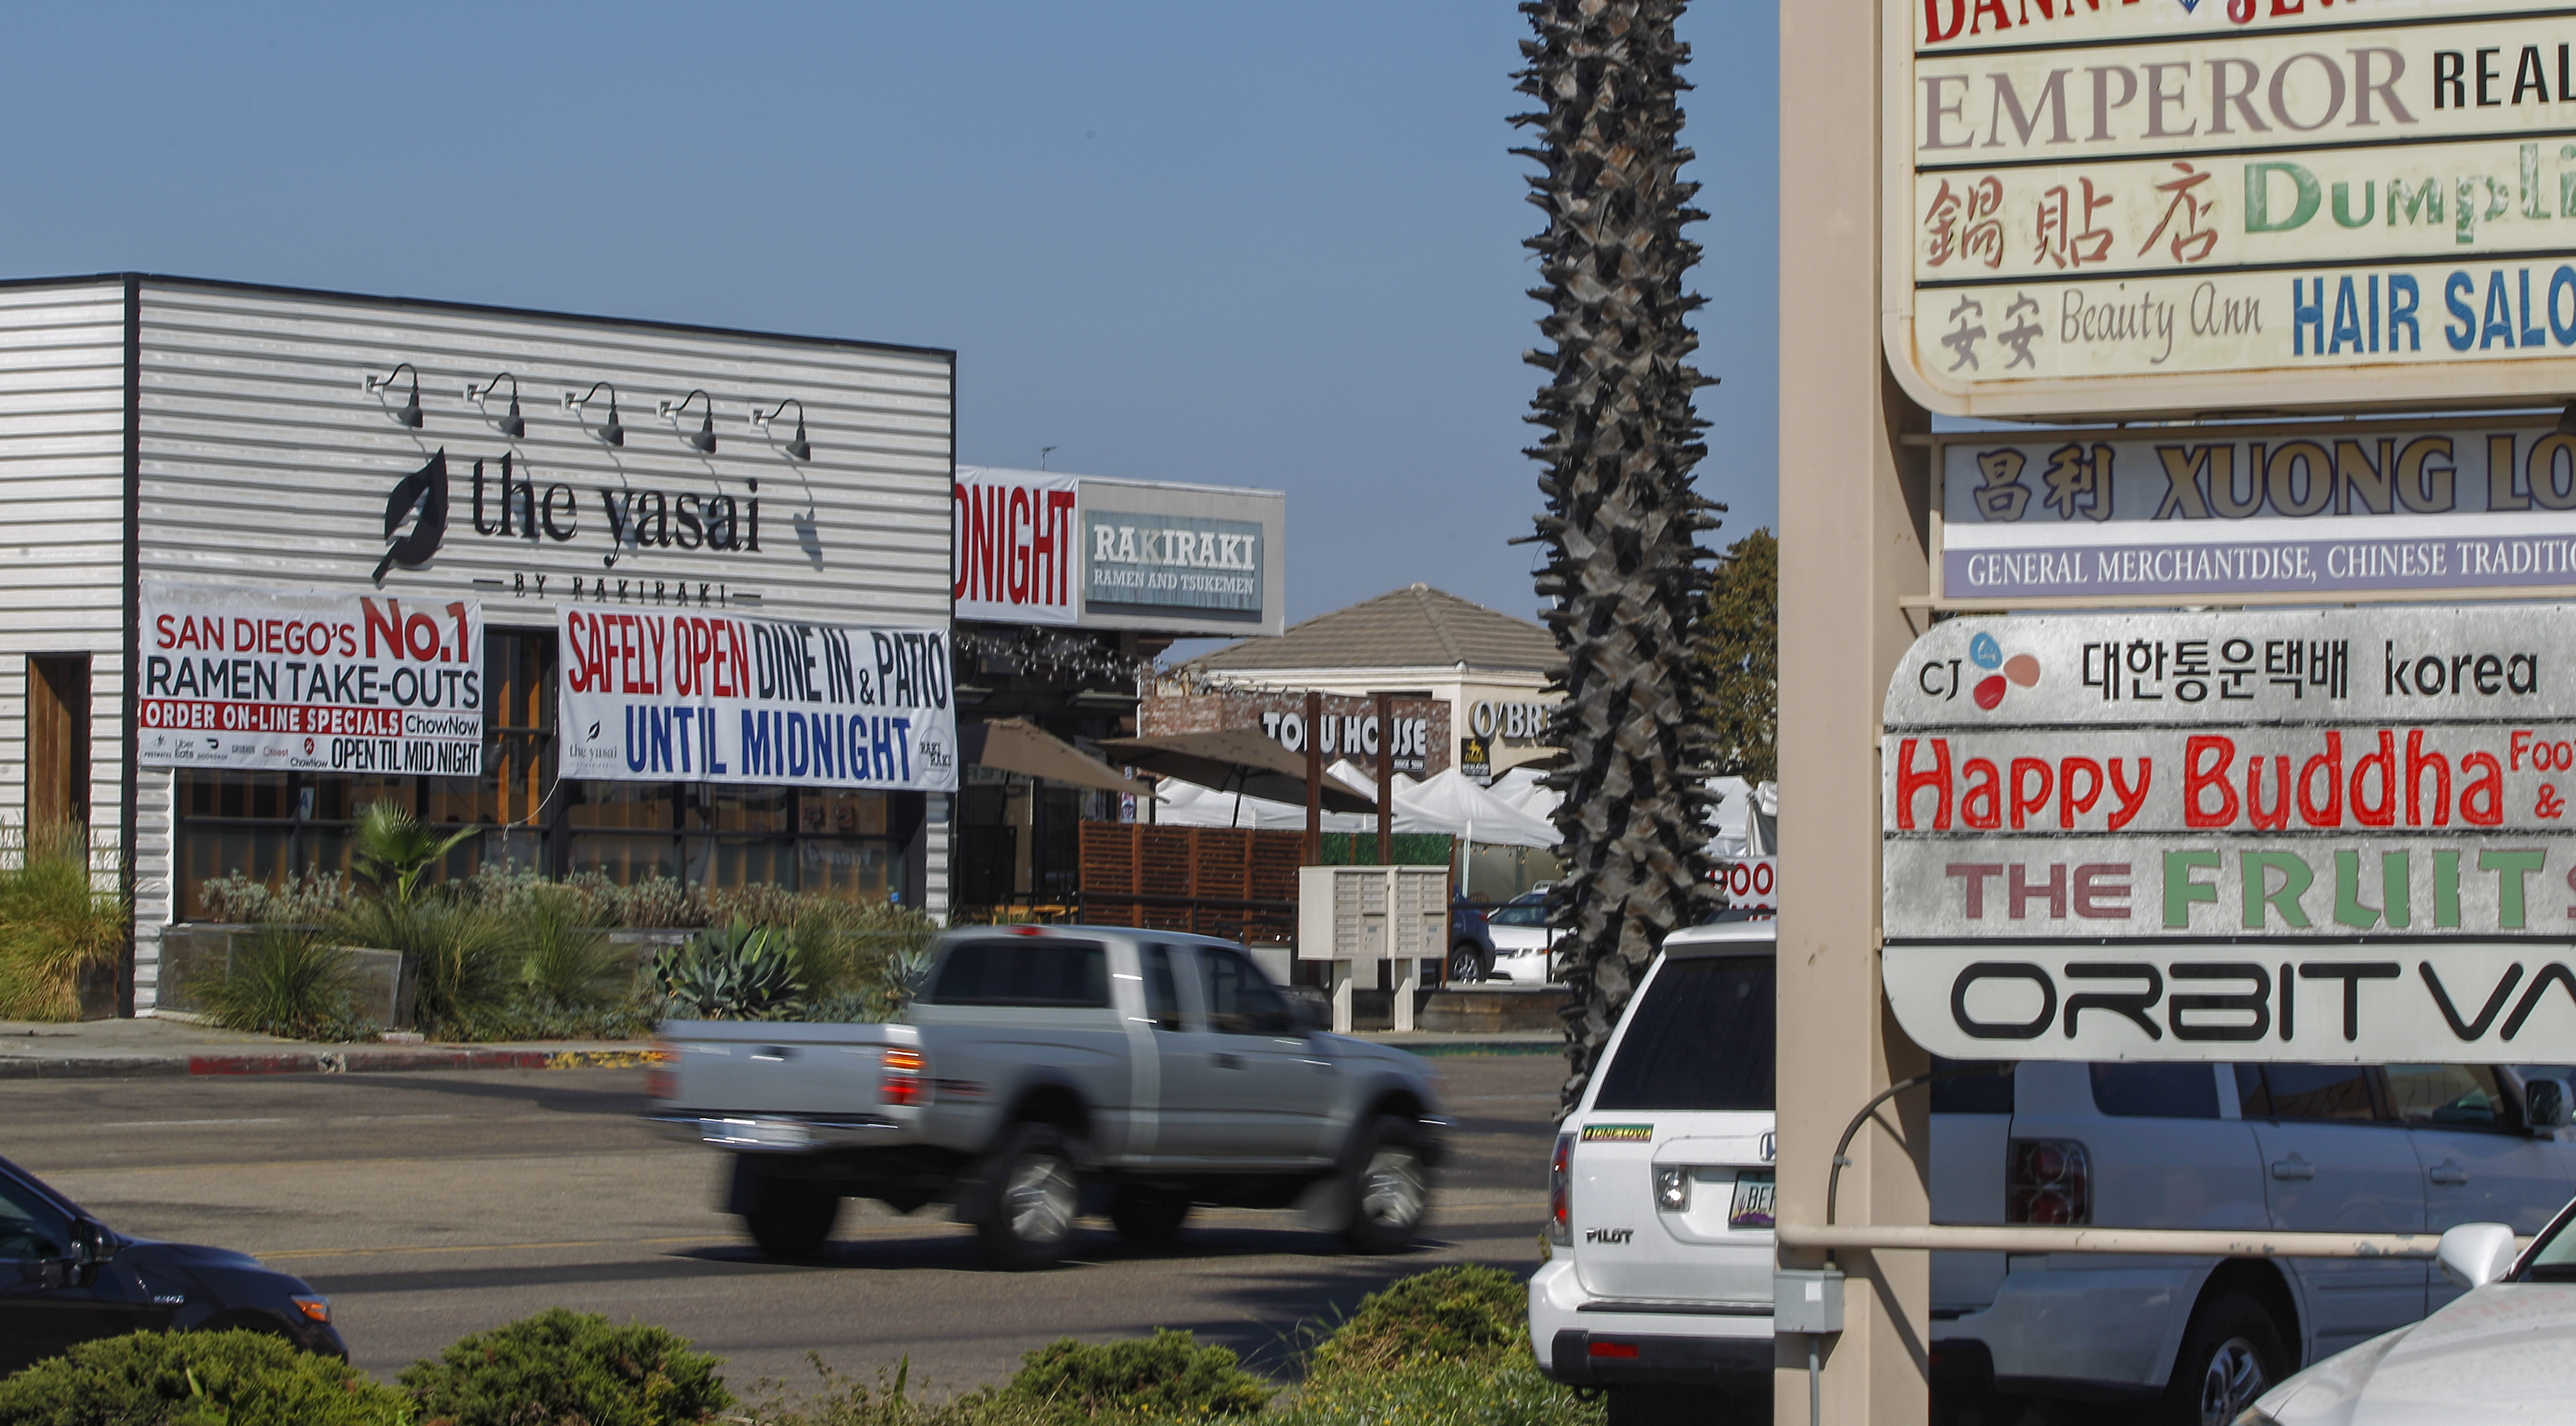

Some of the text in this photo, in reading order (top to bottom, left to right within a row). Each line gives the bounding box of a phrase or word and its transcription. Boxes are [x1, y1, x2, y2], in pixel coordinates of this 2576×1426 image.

[1918, 42, 2576, 151] EMPEROR REAL
[1923, 161, 2219, 269] 鍋貼店
[1940, 291, 2044, 371] 安安
[2060, 281, 2264, 364] Beauty Ann
[2292, 266, 2576, 357] HAIR SALO
[1972, 442, 2115, 523] 昌利
[2152, 431, 2576, 521] XUONG LO
[473, 450, 762, 567] the yasai
[1094, 524, 1255, 571] RAKIRAKI
[1968, 551, 2088, 586] GENERAL
[2097, 546, 2317, 584] MERCHANTDISE,
[2327, 542, 2447, 579] CHINESE
[513, 572, 727, 604] BY RAKIRAKI
[1093, 568, 1254, 595] RAMEN AND TSUKEMEN
[156, 614, 224, 651] SAN
[361, 597, 469, 663] No.1
[146, 655, 479, 709] RAMEN TAKE-OUTS
[568, 610, 947, 709] SAFELY OPEN DINE IN & PATIO
[1920, 638, 2538, 702] CJ 대한통운택배 korea
[146, 702, 479, 736] ORDER ON-LINE SPECIALS ChowNow
[175, 739, 195, 748] Uber
[625, 705, 912, 782] UNTIL MIDNIGHT
[1263, 711, 1336, 754] TOU
[175, 748, 194, 759] Eats
[290, 757, 329, 769] ChowNow
[331, 738, 480, 774] OPEN TIL MID NIGHT
[570, 743, 617, 762] the yasai
[920, 742, 941, 754] RAKI
[930, 752, 951, 766] RAKI
[2510, 730, 2576, 772] Foo
[1896, 730, 2503, 831] Happy Buddha
[2535, 783, 2565, 819] &
[1946, 863, 2131, 920] THE
[2162, 847, 2547, 930] FRUIT
[1950, 962, 2402, 1041] ORBIT
[1586, 1227, 1635, 1244] PILOT
